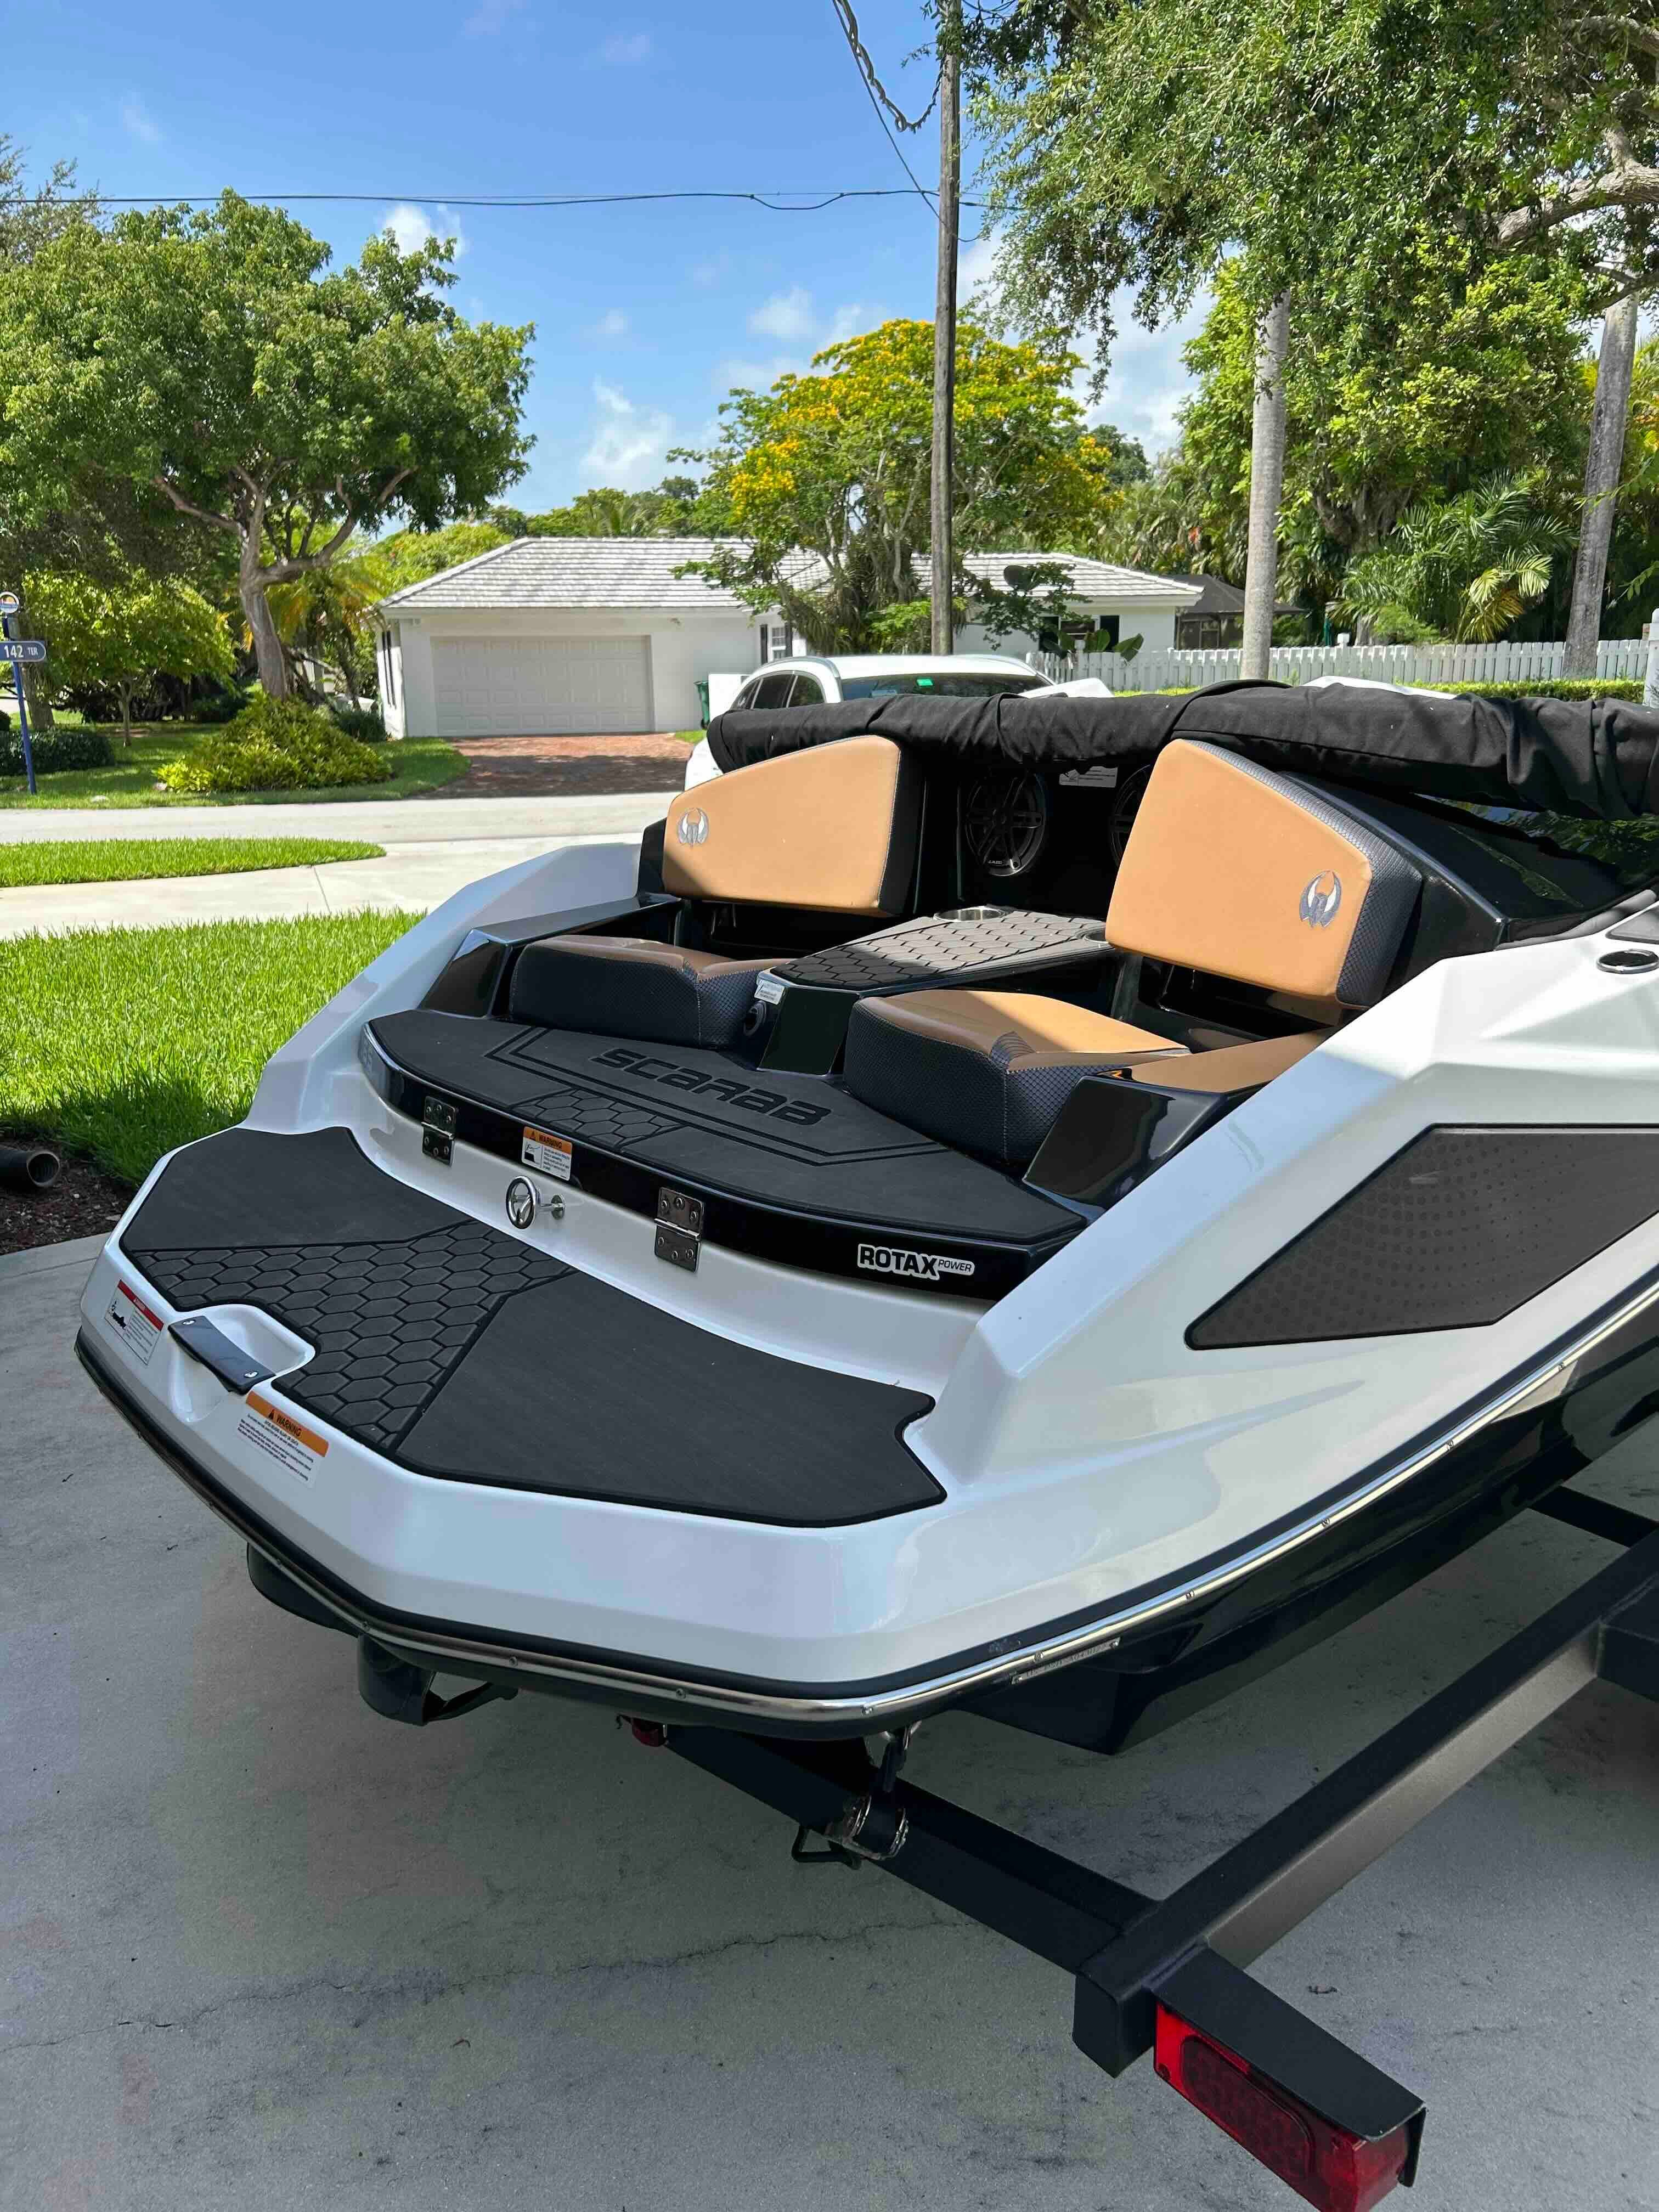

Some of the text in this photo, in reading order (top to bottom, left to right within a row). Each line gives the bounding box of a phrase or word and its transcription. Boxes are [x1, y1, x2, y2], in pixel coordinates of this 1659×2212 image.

[4, 645, 38, 658] 142 TER
[539, 1135, 562, 1150] WARNING
[859, 1245, 972, 1277] ROTAX POWER
[276, 1414, 302, 1437] WARNING
